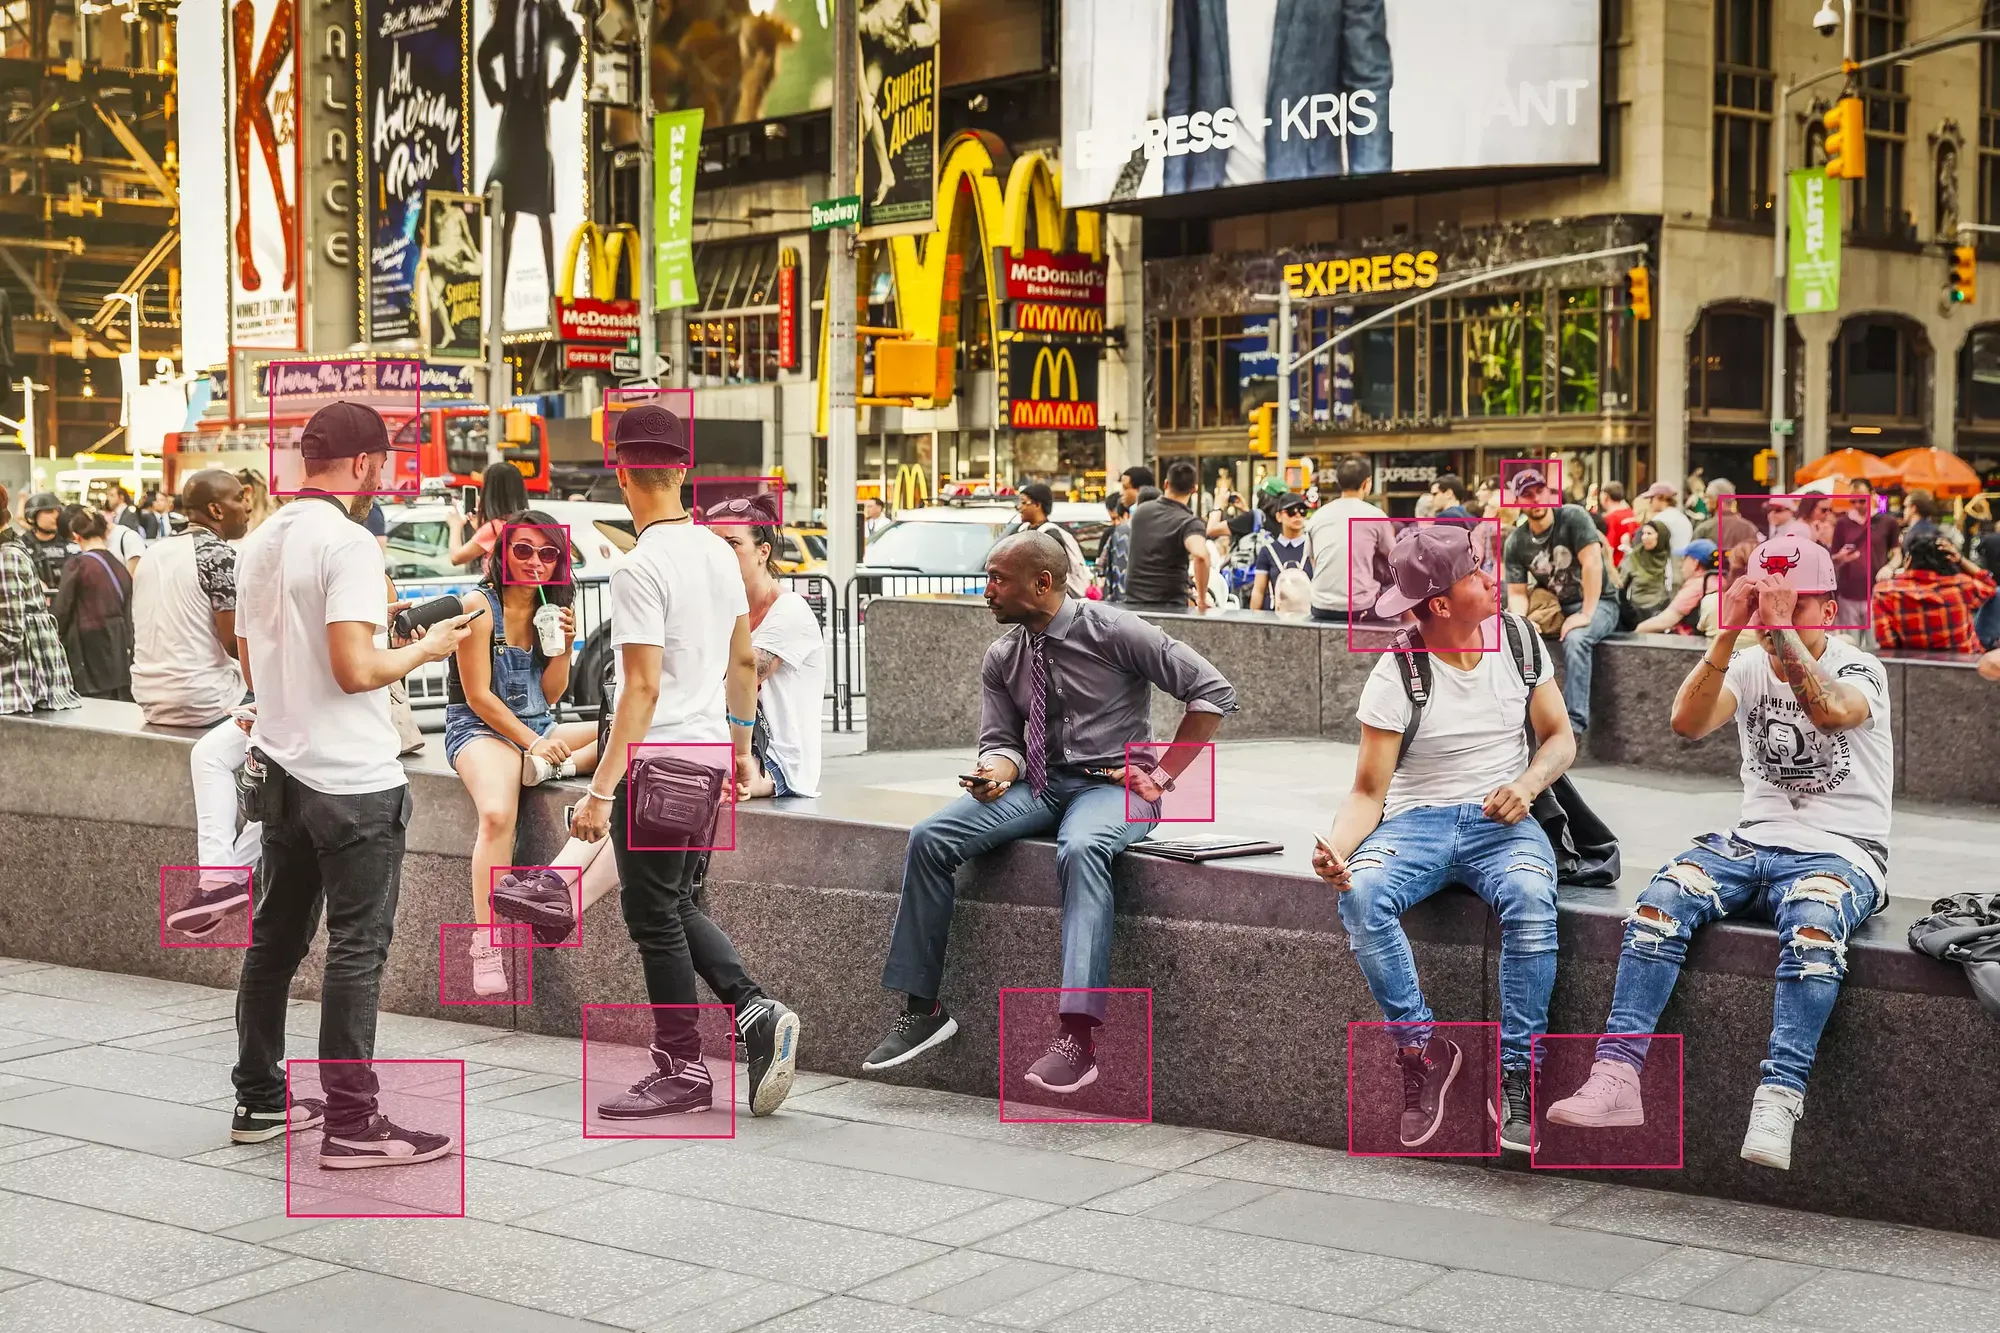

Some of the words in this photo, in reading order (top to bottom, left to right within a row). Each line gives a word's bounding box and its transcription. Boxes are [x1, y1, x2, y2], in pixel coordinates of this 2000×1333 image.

[881, 60, 932, 120] SHUFFLE
[325, 0, 349, 264] ALACE
[889, 98, 932, 159] ALONG
[1077, 107, 1237, 169] EPRESS
[1281, 89, 1378, 142] KRIS
[812, 202, 859, 226] Broadway
[1011, 263, 1105, 289] McDonald's
[1283, 250, 1439, 298] EXPRESS
[562, 309, 641, 329] McDonald
[1379, 466, 1437, 484] EXPRESS
